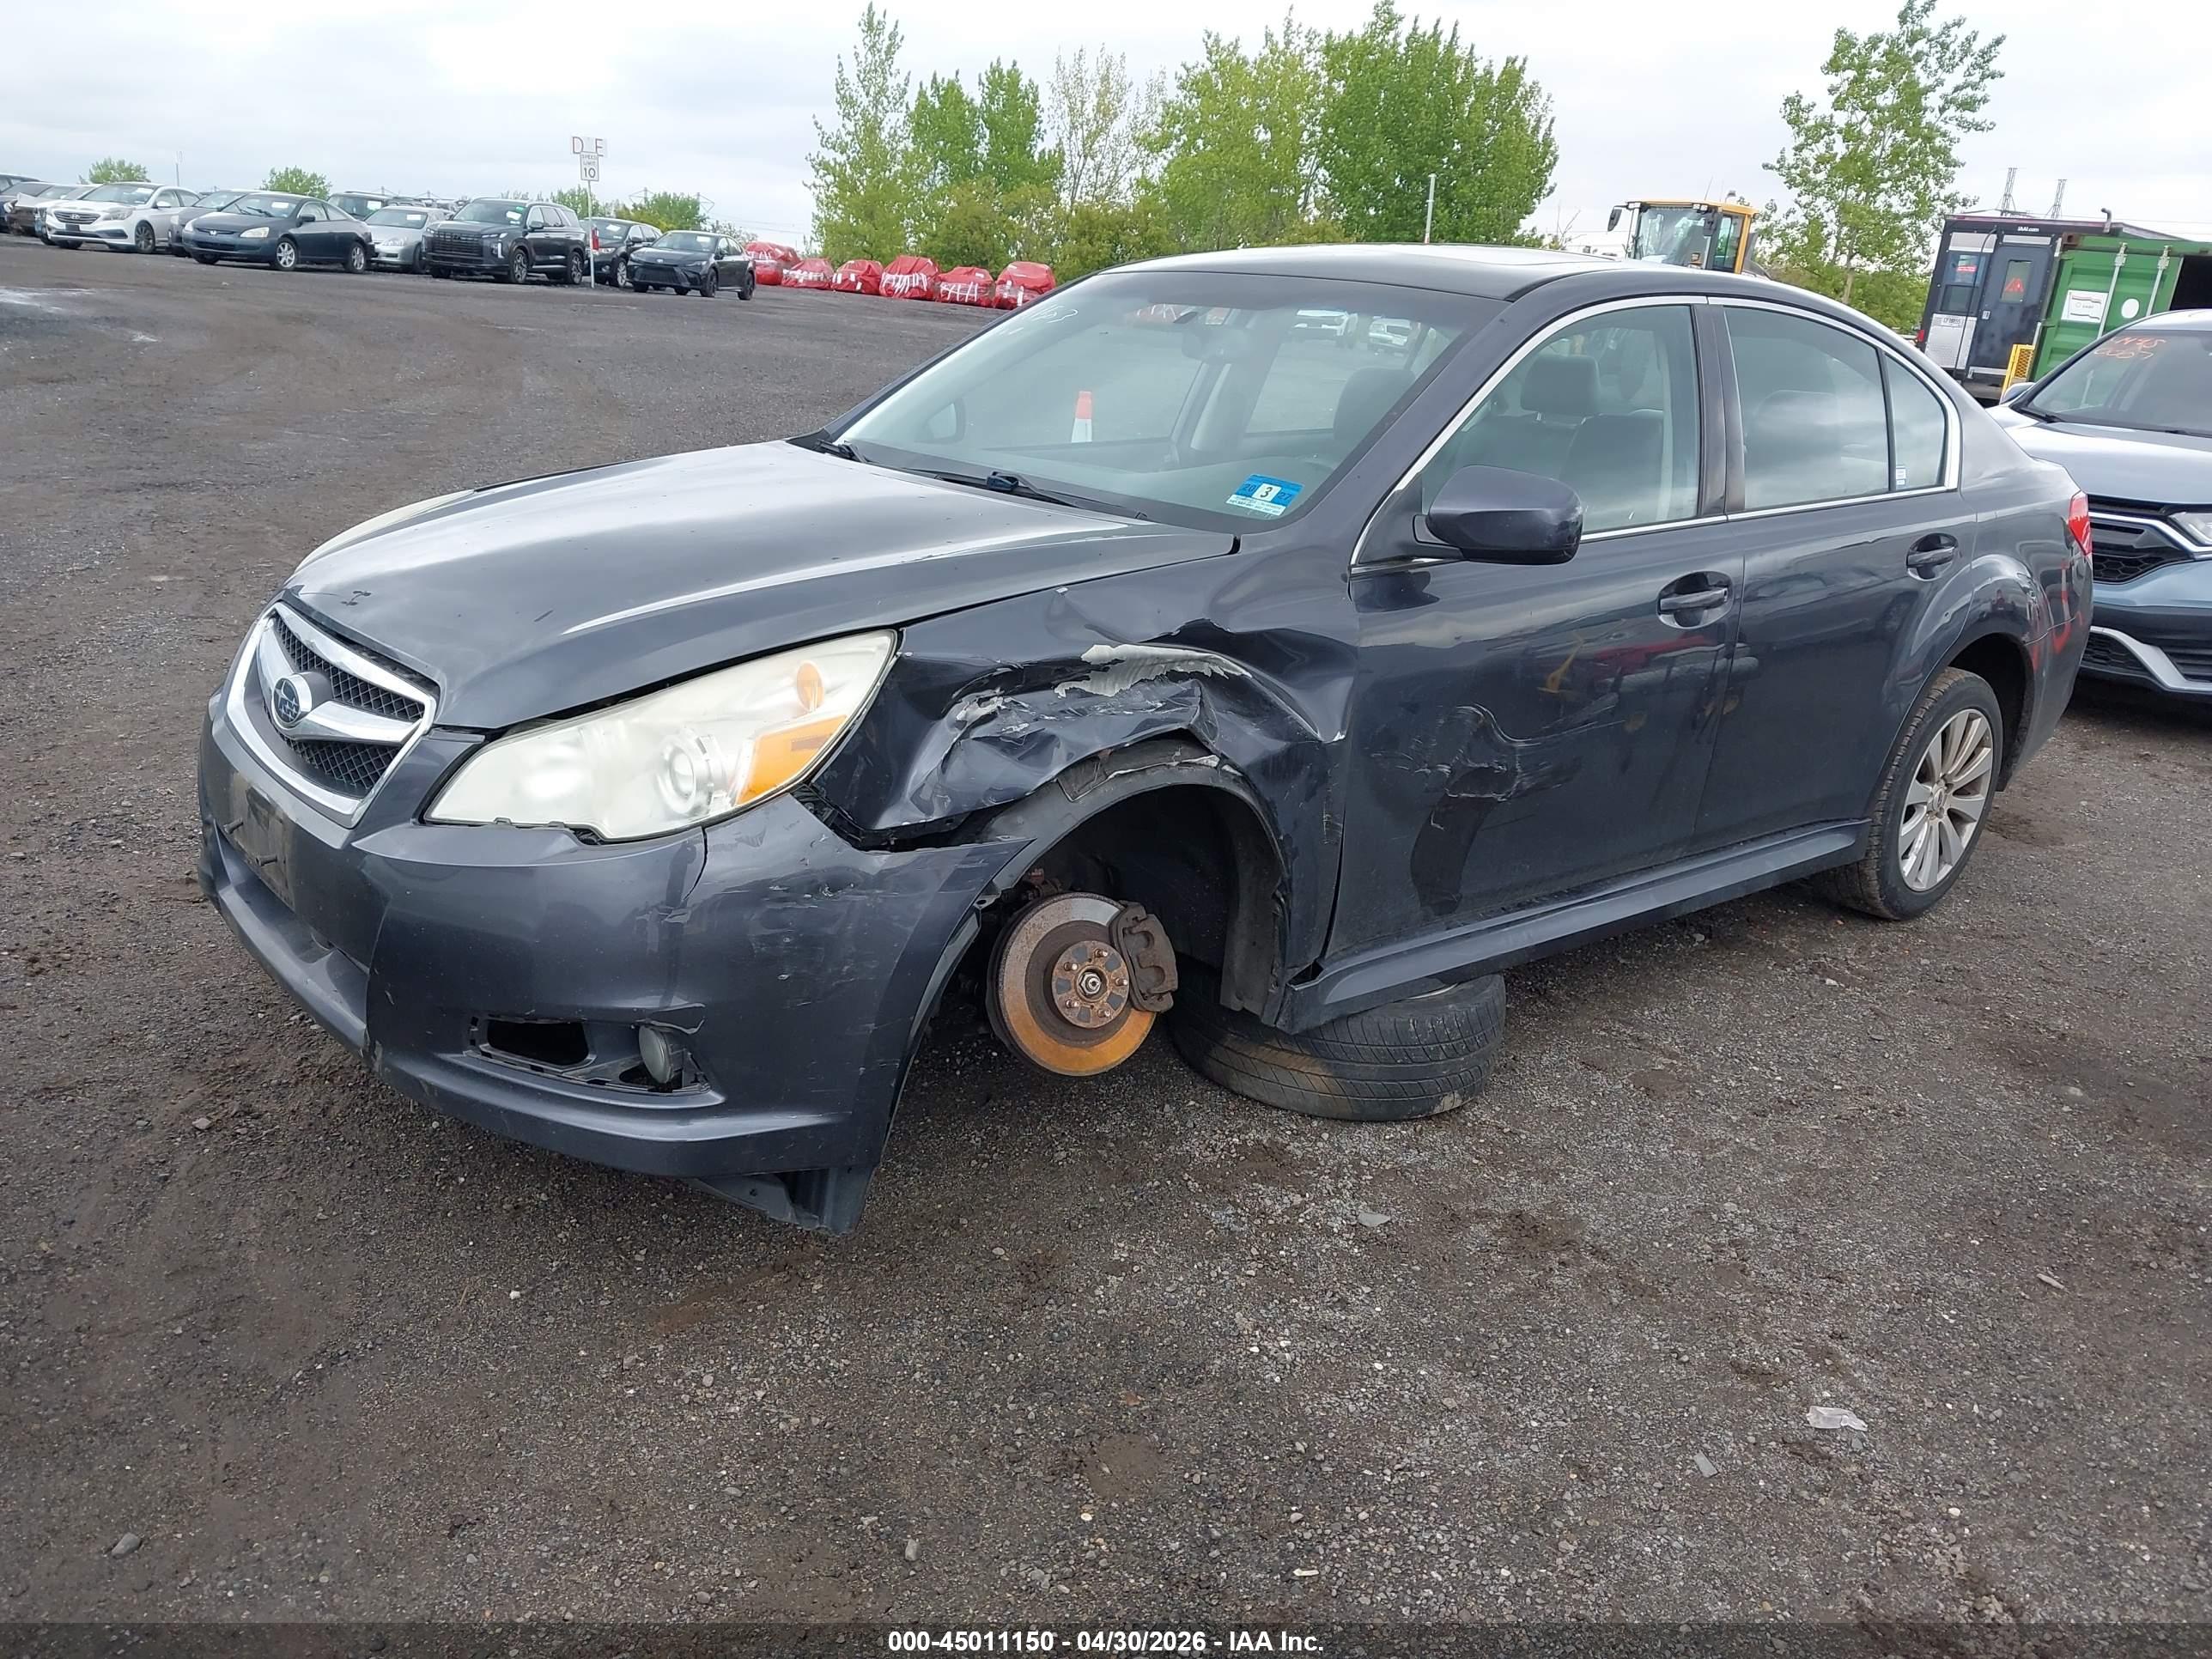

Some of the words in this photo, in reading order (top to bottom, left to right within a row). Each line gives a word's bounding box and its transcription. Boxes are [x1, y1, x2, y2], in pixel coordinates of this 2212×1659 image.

[573, 137, 584, 154] D
[583, 167, 596, 179] 10
[1260, 486, 1273, 498] 3
